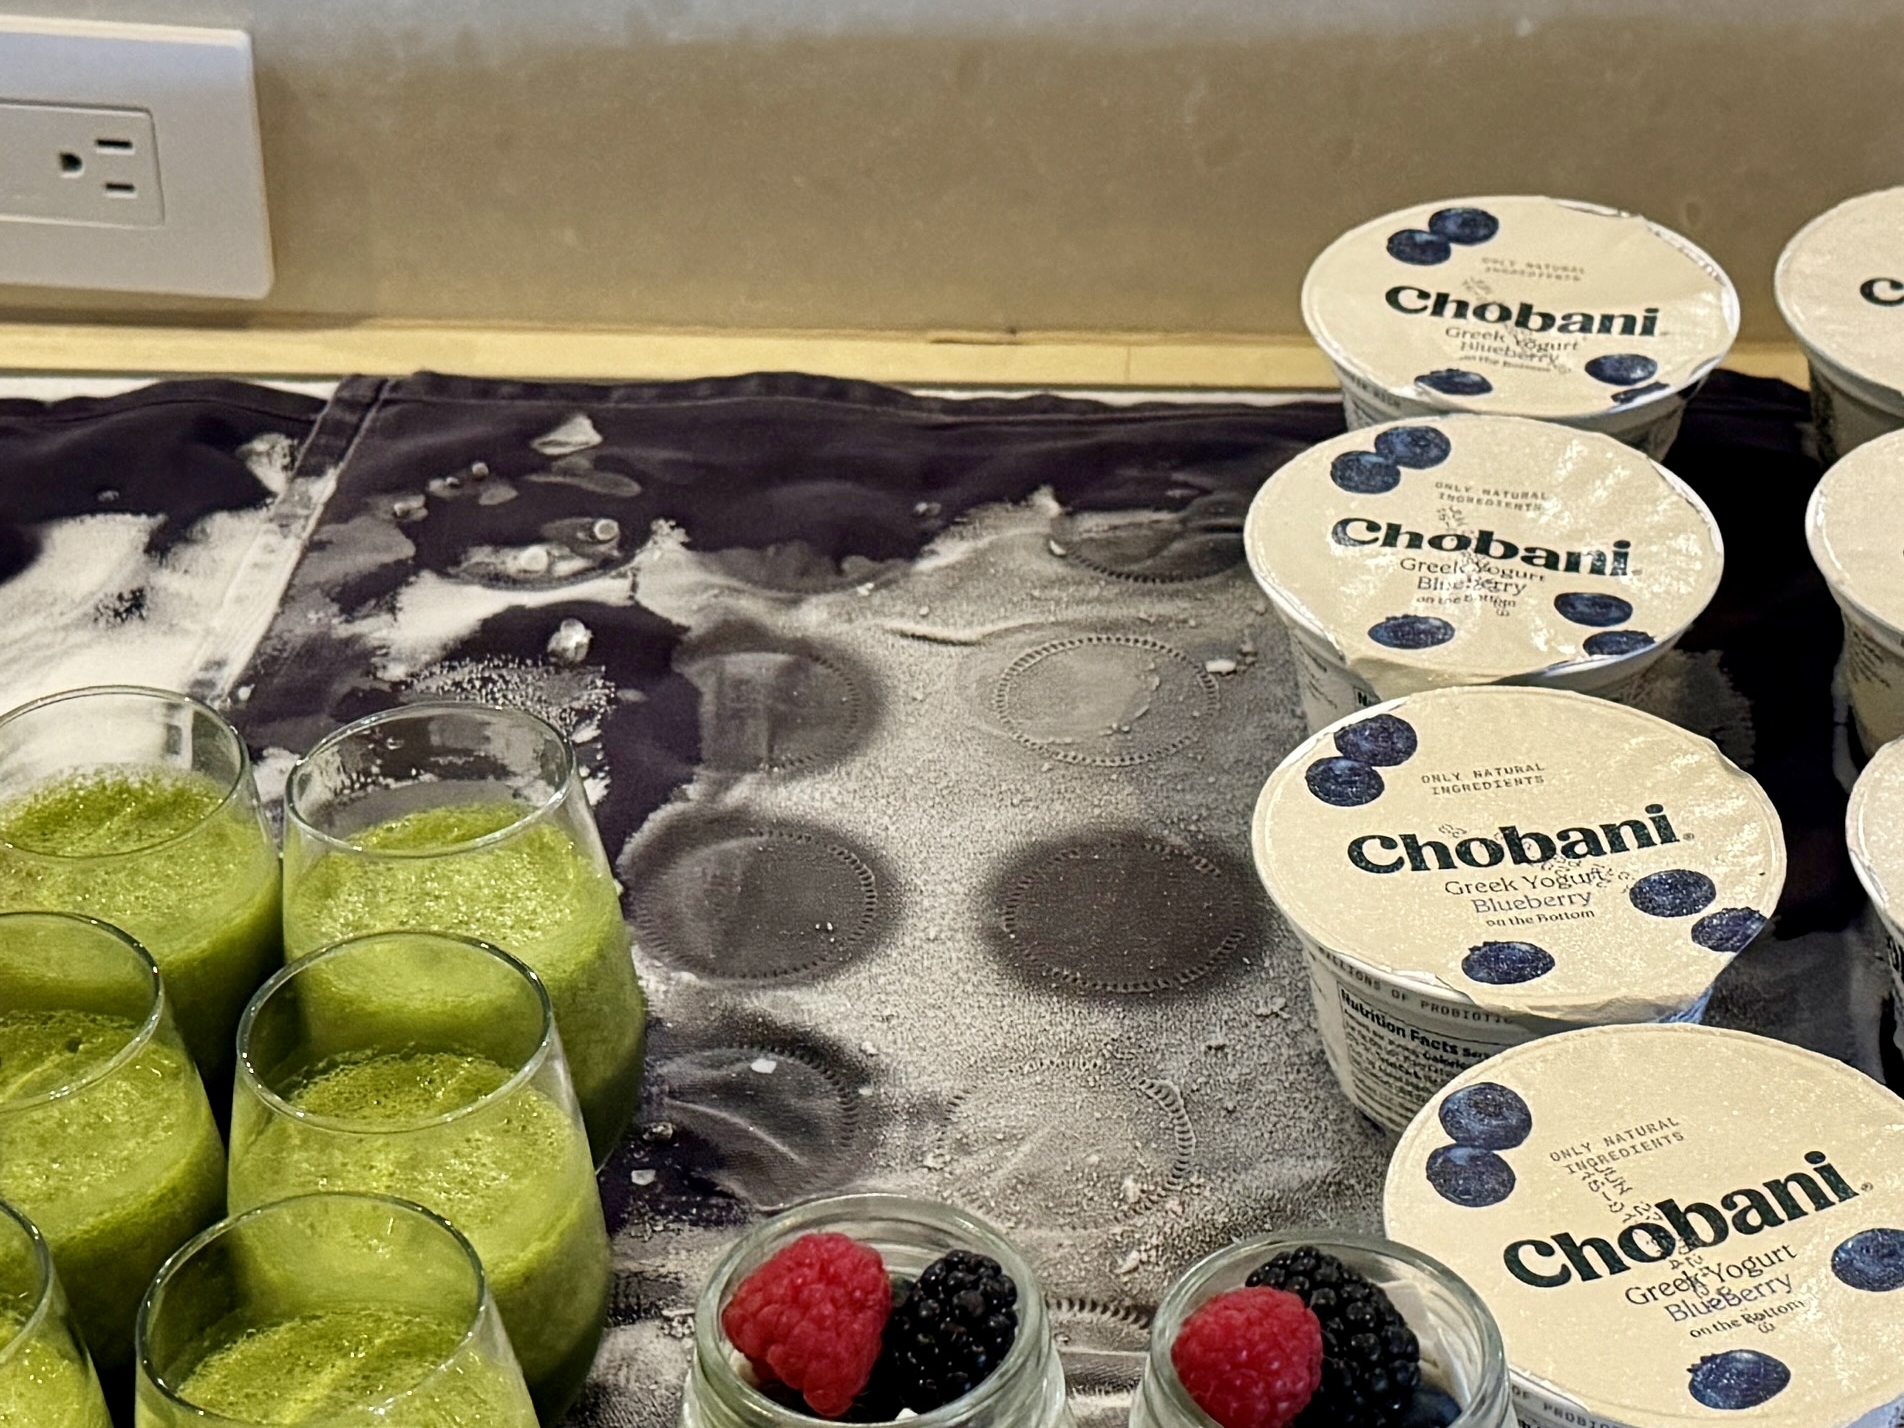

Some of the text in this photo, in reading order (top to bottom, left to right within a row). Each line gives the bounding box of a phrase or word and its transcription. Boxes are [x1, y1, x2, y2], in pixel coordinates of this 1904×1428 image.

[1385, 285, 1659, 338] Chobani
[1446, 327, 1505, 343] Greek
[1435, 481, 1547, 501] ONLY NATURAL
[1439, 492, 1543, 512] INGREDIENTS
[1331, 517, 1631, 577] Chobani
[1421, 763, 1545, 785] ONLY NATURAL
[1431, 775, 1545, 796] INGREDIENTS
[1347, 804, 1681, 875] Chobani
[1445, 869, 1605, 896] Greek Yogurt
[1472, 890, 1593, 914] Blueberry
[1507, 913, 1534, 926] the
[1536, 907, 1596, 925] Bottom
[1341, 988, 1407, 1039] Nutrition
[1410, 1029, 1460, 1056] Facts
[1549, 1116, 1680, 1162] ONLY NATURAL
[1564, 1130, 1685, 1174] INGREDIENTS
[1503, 1150, 1860, 1289] Chobani
[1624, 1242, 1799, 1306] Greek Yogurt
[1689, 1325, 1713, 1339] on
[1712, 1317, 1742, 1335] the
